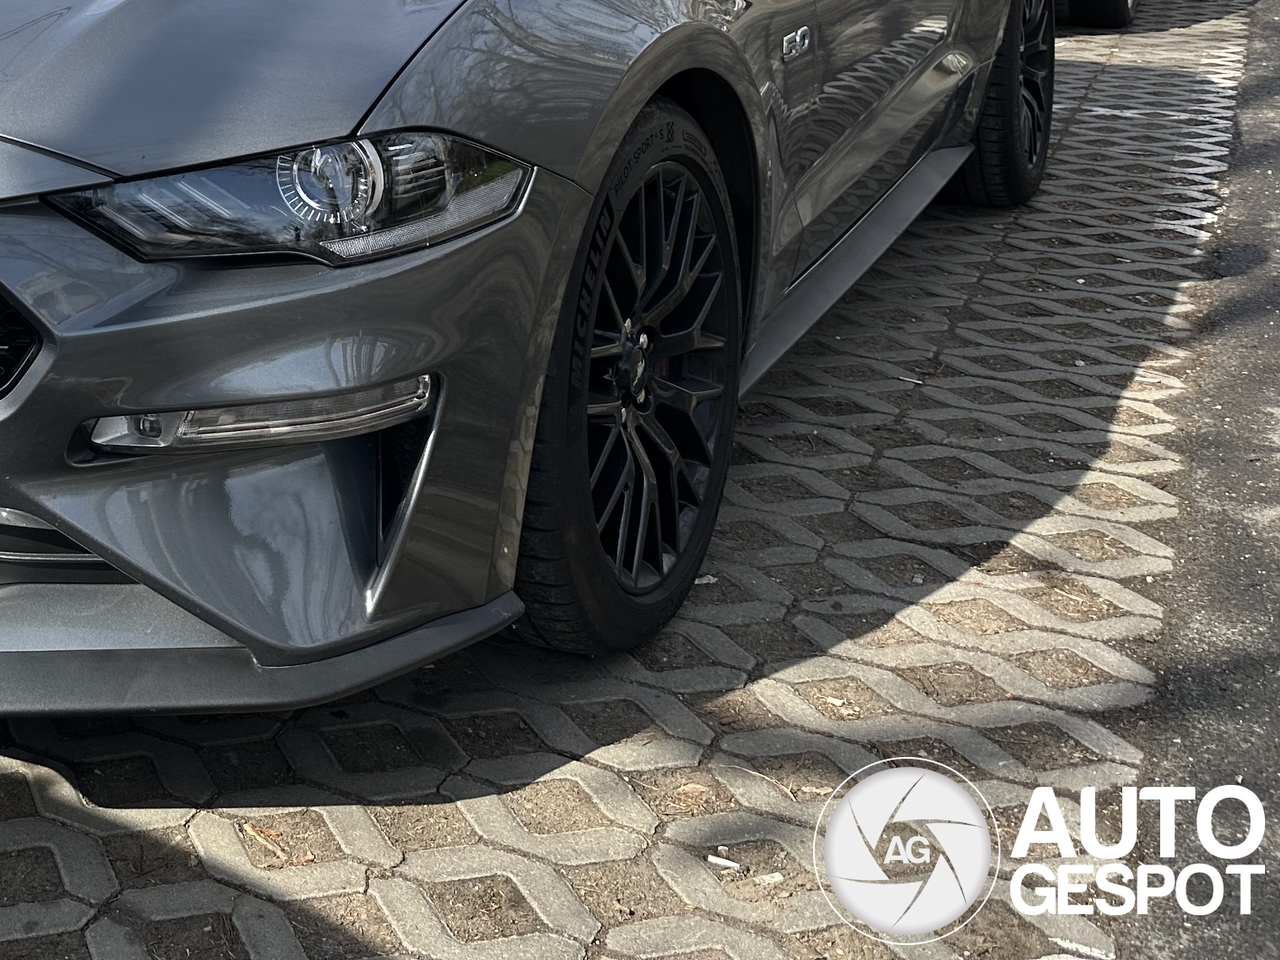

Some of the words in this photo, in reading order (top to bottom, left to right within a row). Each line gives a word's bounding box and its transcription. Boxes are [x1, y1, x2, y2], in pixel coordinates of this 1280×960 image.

[613, 158, 634, 197] PILOT
[633, 133, 656, 165] SPORT
[570, 205, 613, 389] MICHELIN
